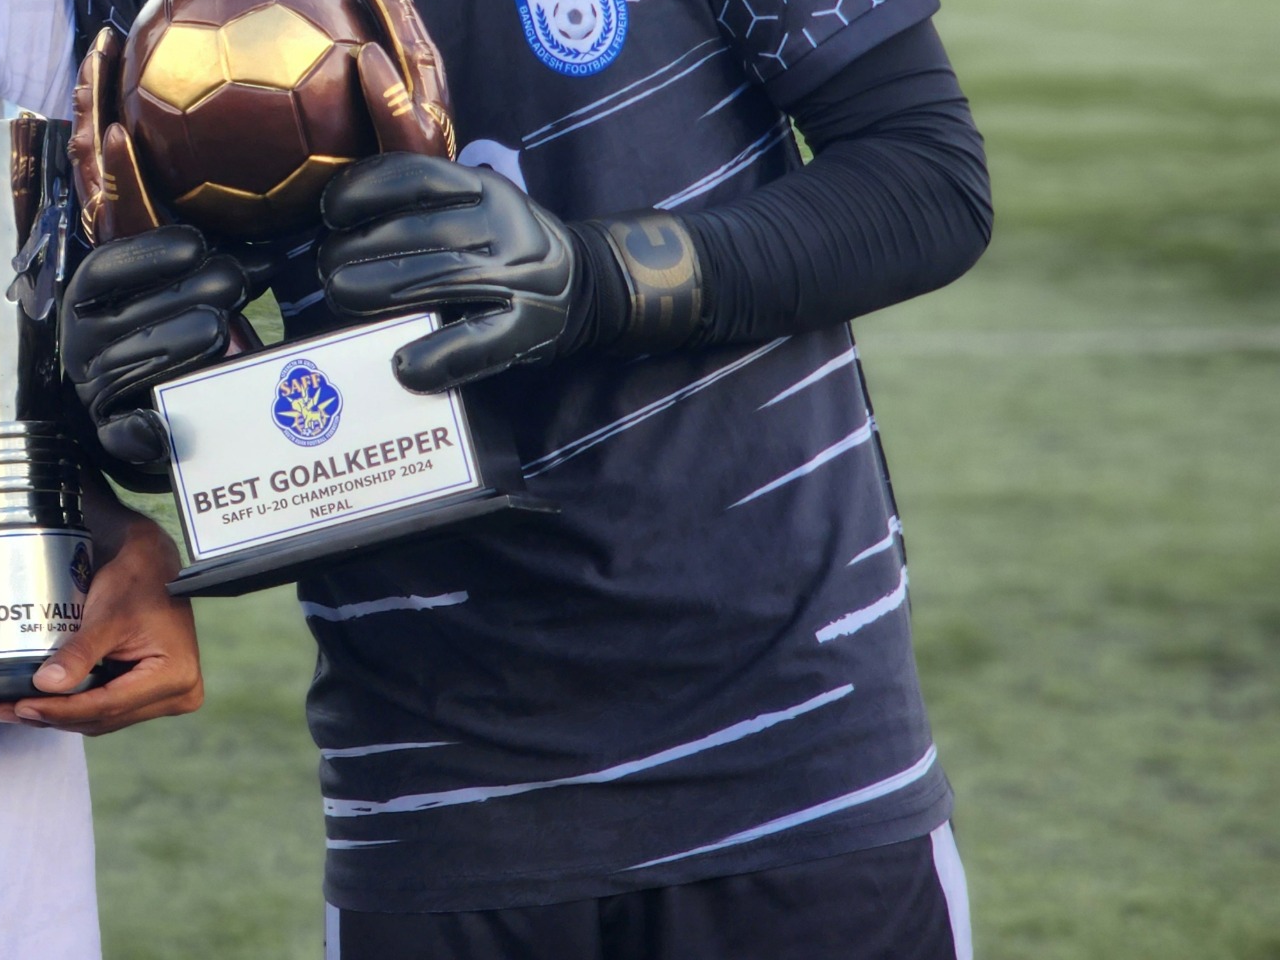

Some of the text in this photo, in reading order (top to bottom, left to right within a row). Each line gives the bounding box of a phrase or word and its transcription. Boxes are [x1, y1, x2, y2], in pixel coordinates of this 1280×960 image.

[520, 5, 564, 73] BANGLADESH
[564, 49, 617, 75] FOOTBALL
[280, 373, 321, 397] SAFF
[192, 425, 455, 515] BEST GOALKEEPER
[221, 458, 434, 525] SAFF U-20 CHAMPIONSHIP 2024
[310, 498, 354, 520] NEPAL
[40, 603, 85, 621] VALU
[47, 623, 67, 632] U-20
[68, 623, 81, 633] CH
